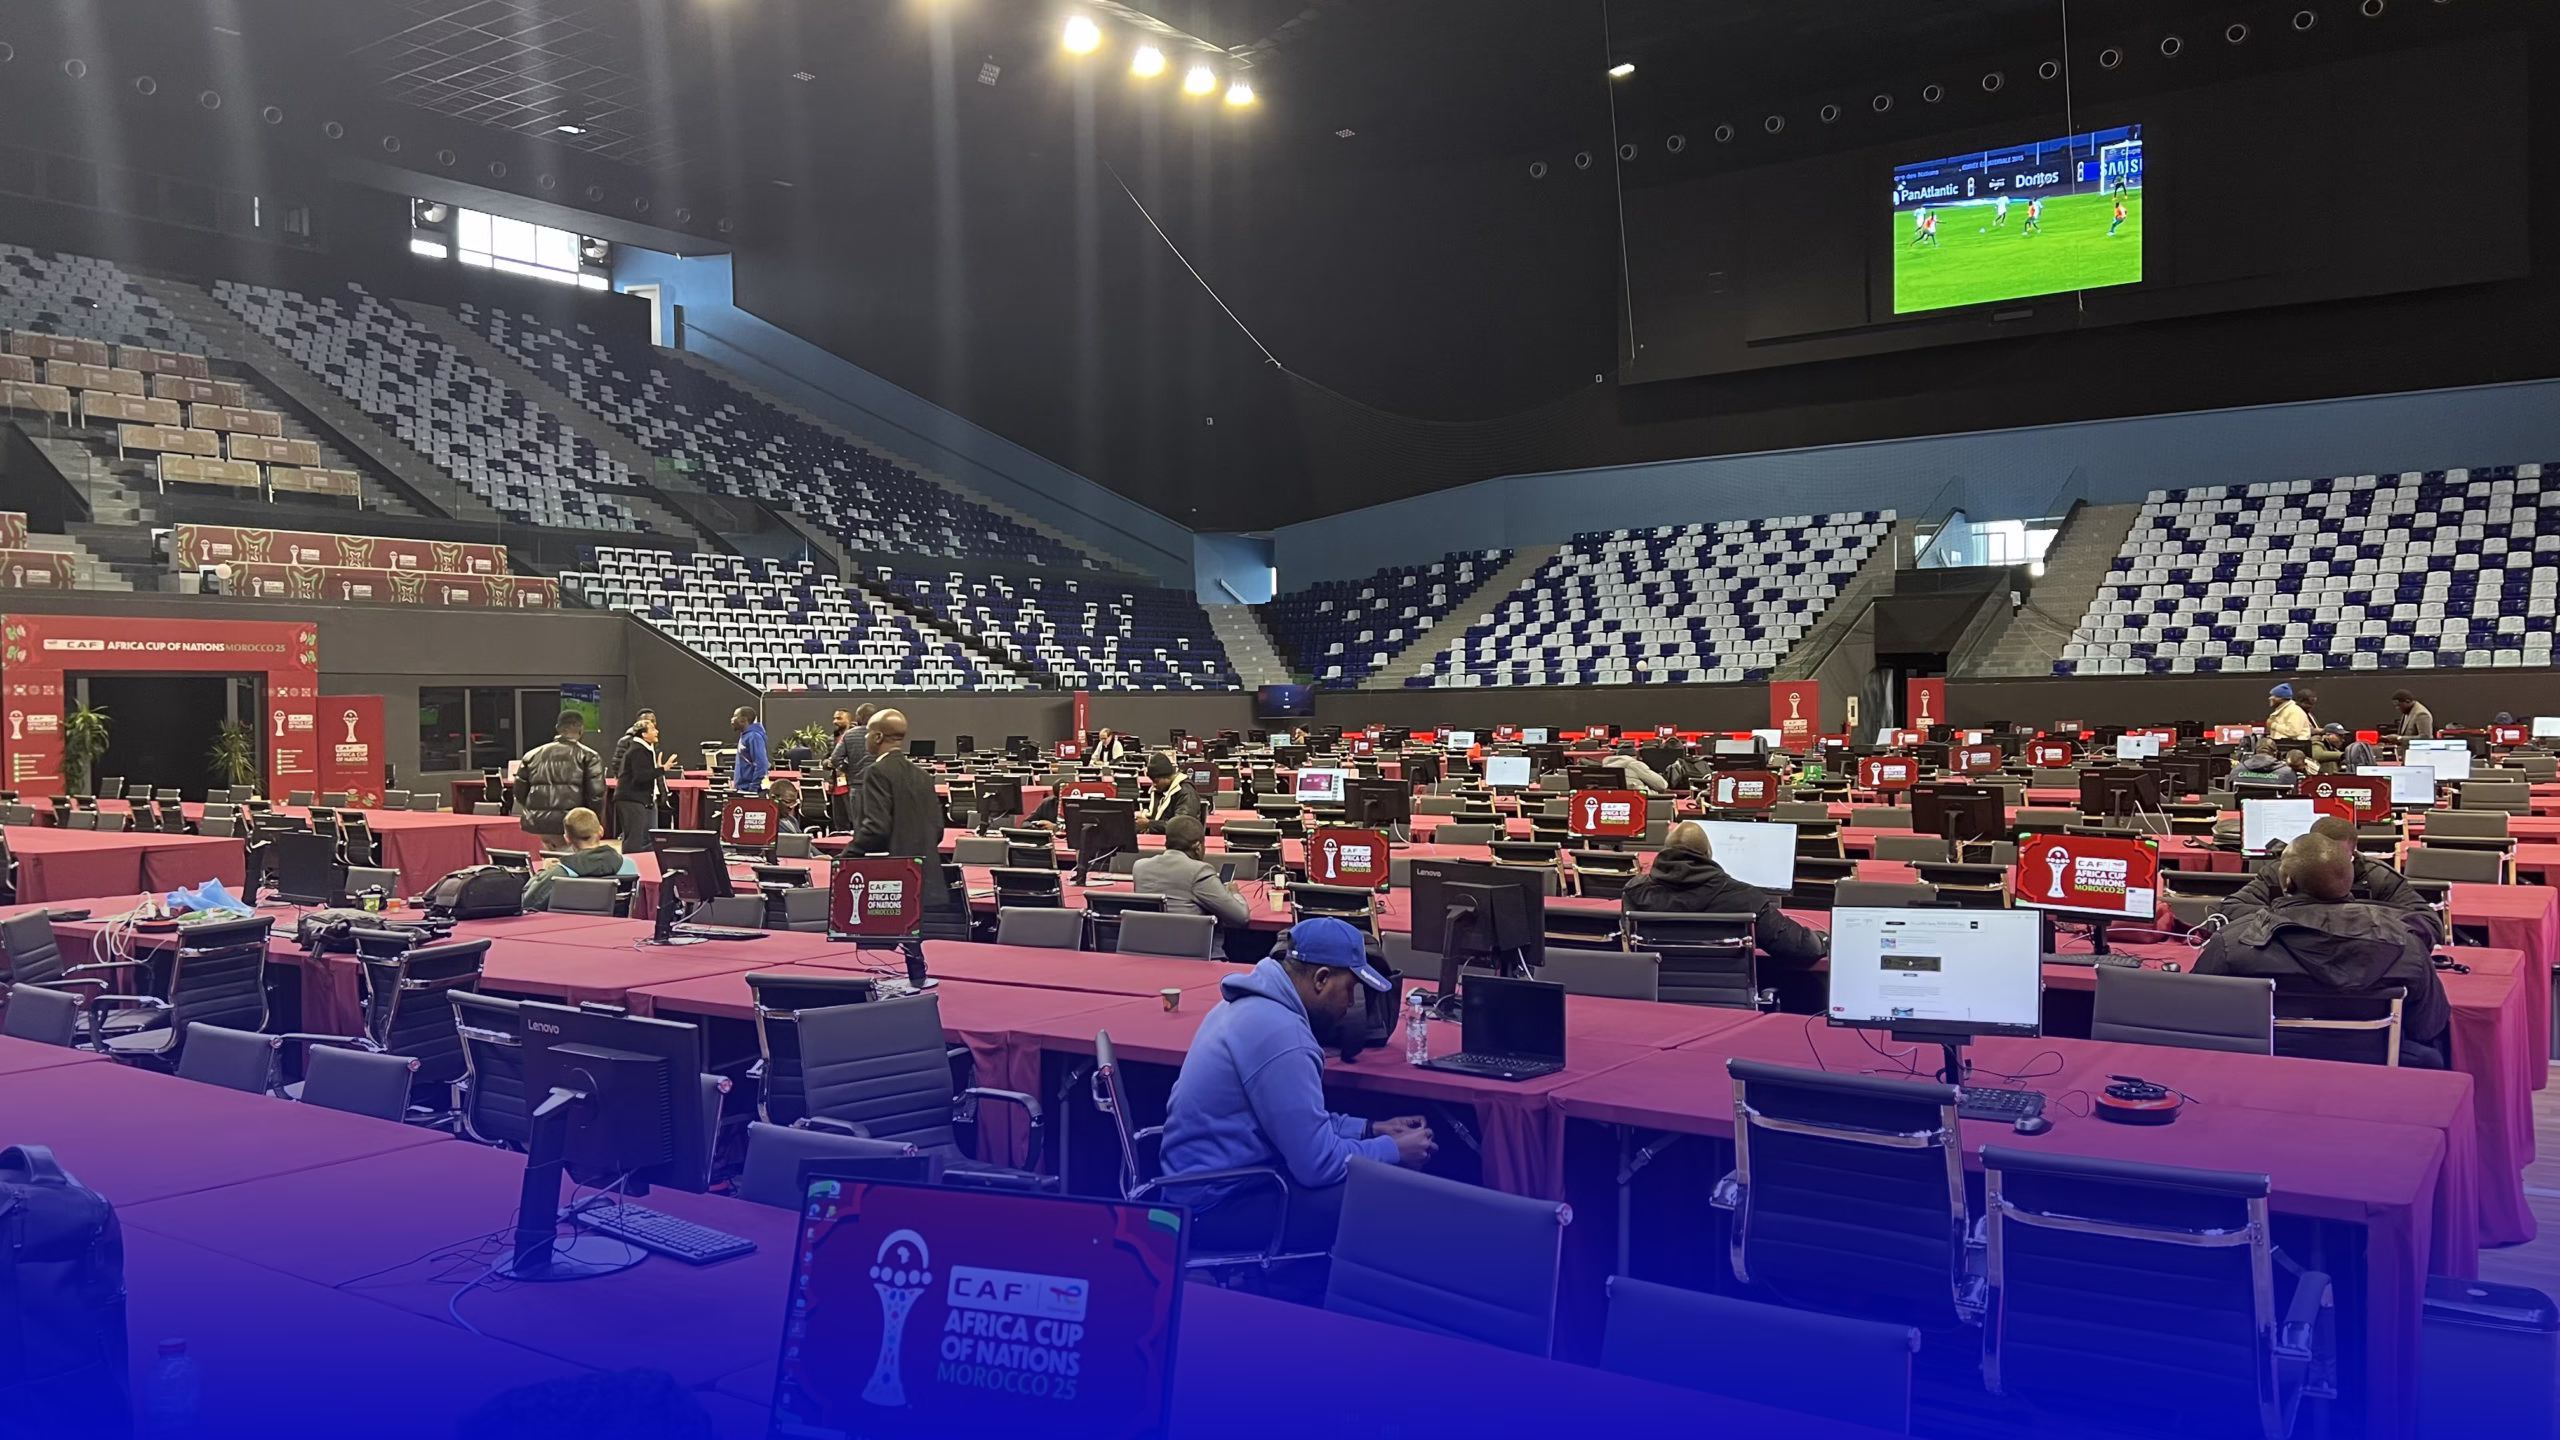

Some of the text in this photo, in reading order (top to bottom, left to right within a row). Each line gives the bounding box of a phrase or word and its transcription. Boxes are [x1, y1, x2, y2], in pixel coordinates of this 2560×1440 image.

[2015, 171, 2059, 188] Doritos
[1901, 183, 1959, 202] PanAtlantic
[107, 641, 145, 650] AFRICA
[145, 641, 166, 650] CUP
[167, 642, 181, 651] OF
[182, 642, 225, 652] NATIONS
[225, 643, 274, 652] MOROCCO
[275, 644, 286, 652] 25
[1416, 868, 1442, 877] Lenovo
[2076, 869, 2126, 880] AFRICA CUP
[2074, 884, 2116, 893] MOROCCO
[2075, 876, 2126, 888] OF NATIONS
[868, 893, 902, 901] AFRICA CUP
[877, 901, 901, 909] NATIONS
[527, 1019, 560, 1035] Lenovo
[954, 1277, 1023, 1301] CAF
[944, 1309, 1084, 1348] AFRICA CUP
[941, 1335, 1081, 1377] OF NATIONS
[937, 1361, 1077, 1400] MOROCCO 25
